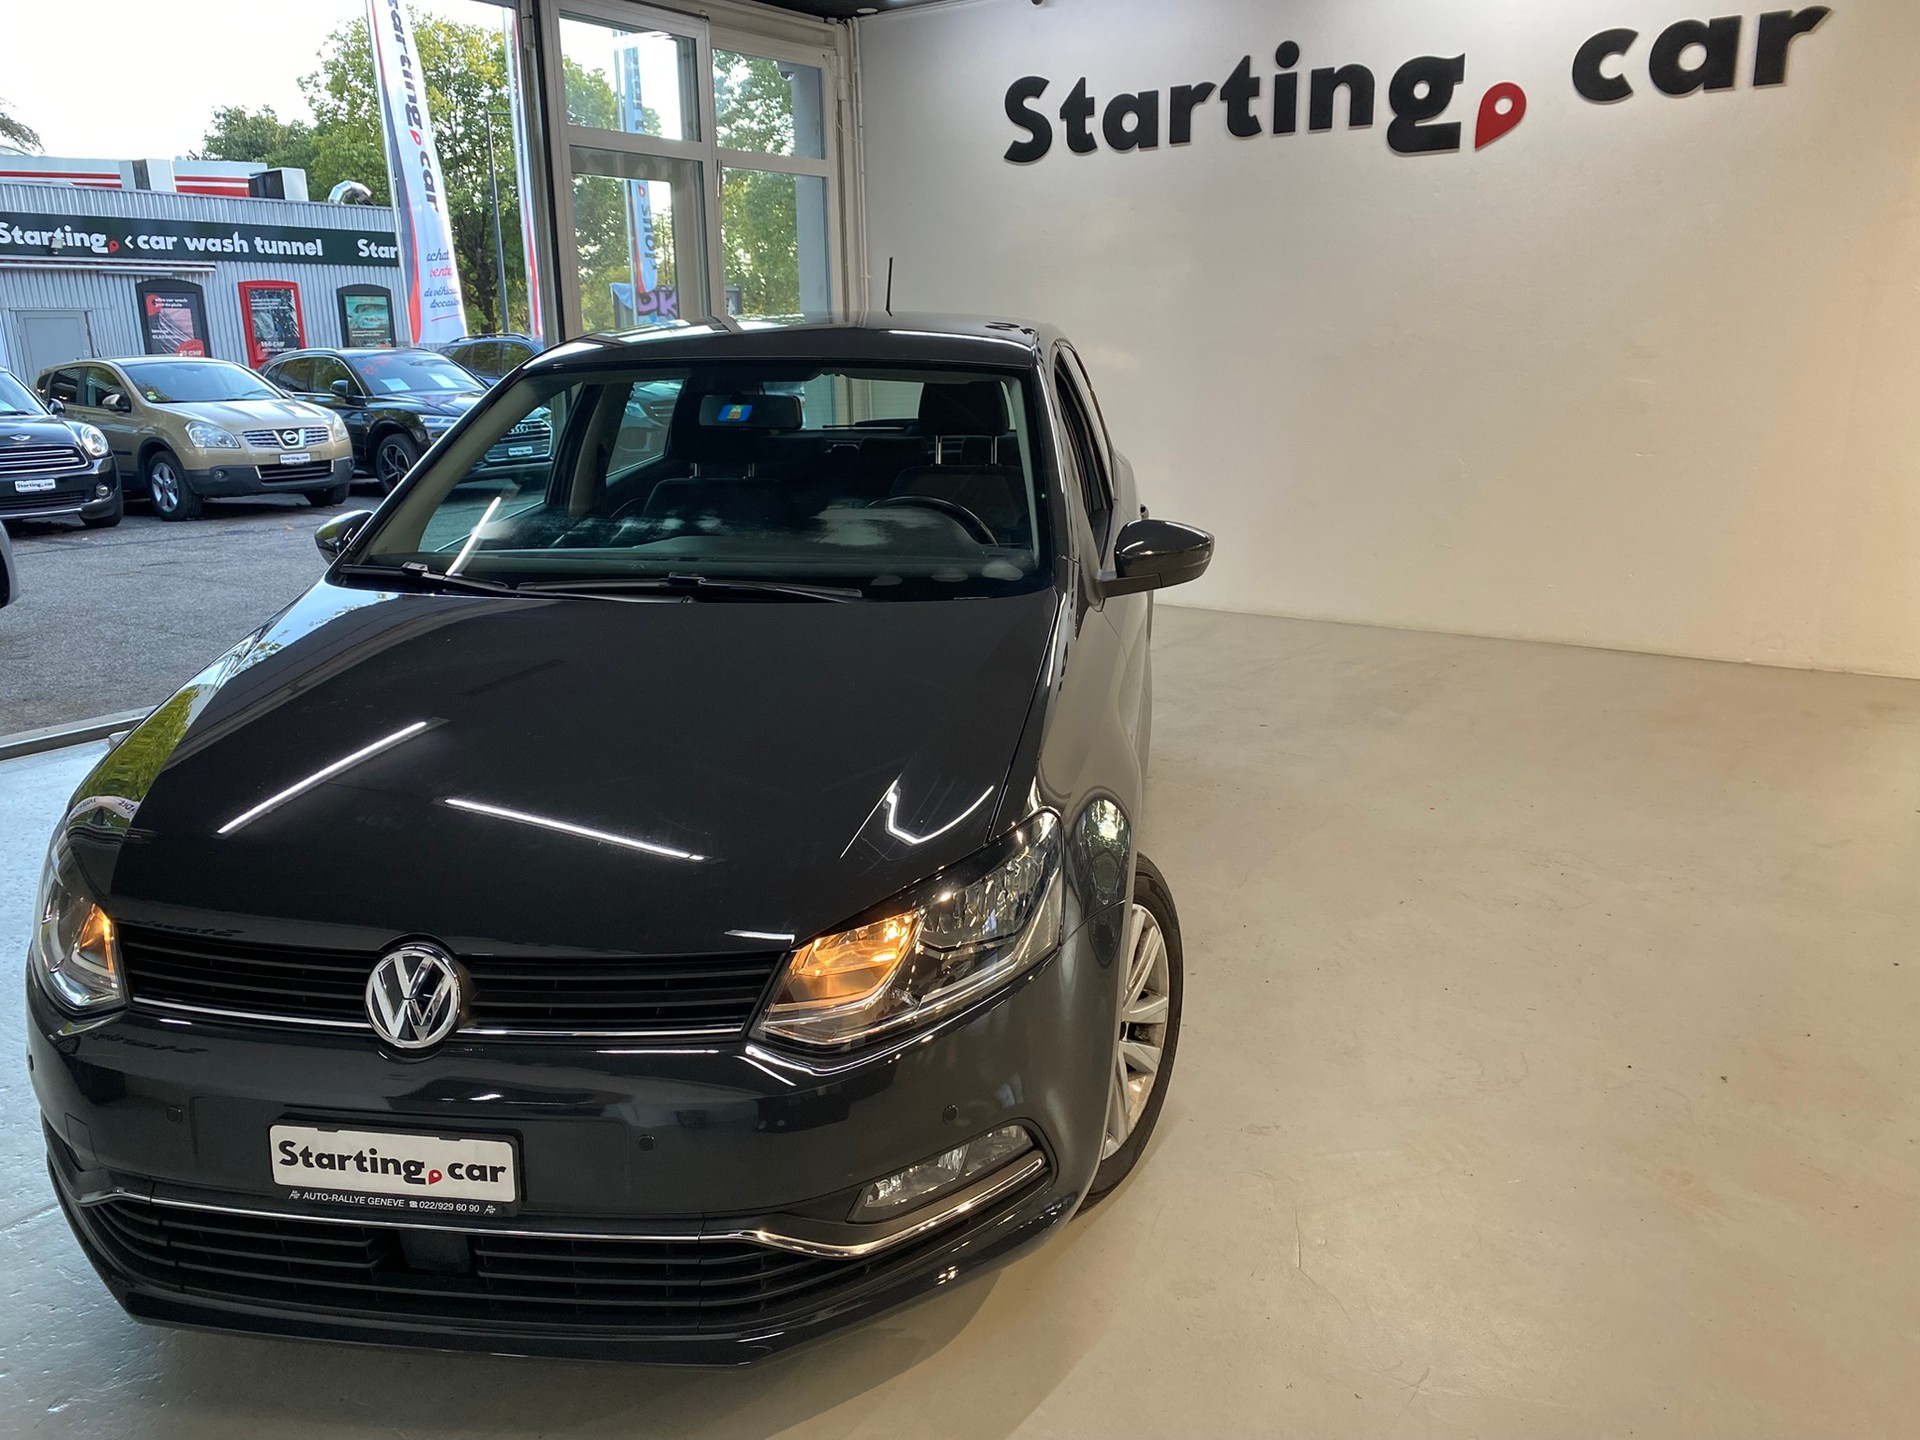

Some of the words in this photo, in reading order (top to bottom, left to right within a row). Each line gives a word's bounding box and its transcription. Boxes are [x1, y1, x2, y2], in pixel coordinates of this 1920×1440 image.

[1003, 40, 1466, 162] Starting
[1572, 5, 1832, 102] car
[419, 151, 439, 212] car
[136, 235, 178, 250] car
[183, 231, 249, 253] wash
[254, 236, 323, 256] tunnel
[279, 1140, 426, 1185] Starting
[447, 1161, 507, 1183] car
[303, 1192, 365, 1205] AUTO-RALLYE
[367, 1197, 405, 1208] GENEVE
[419, 1200, 454, 1211] 022/929
[456, 1203, 467, 1212] 60
[468, 1204, 480, 1213] 90
